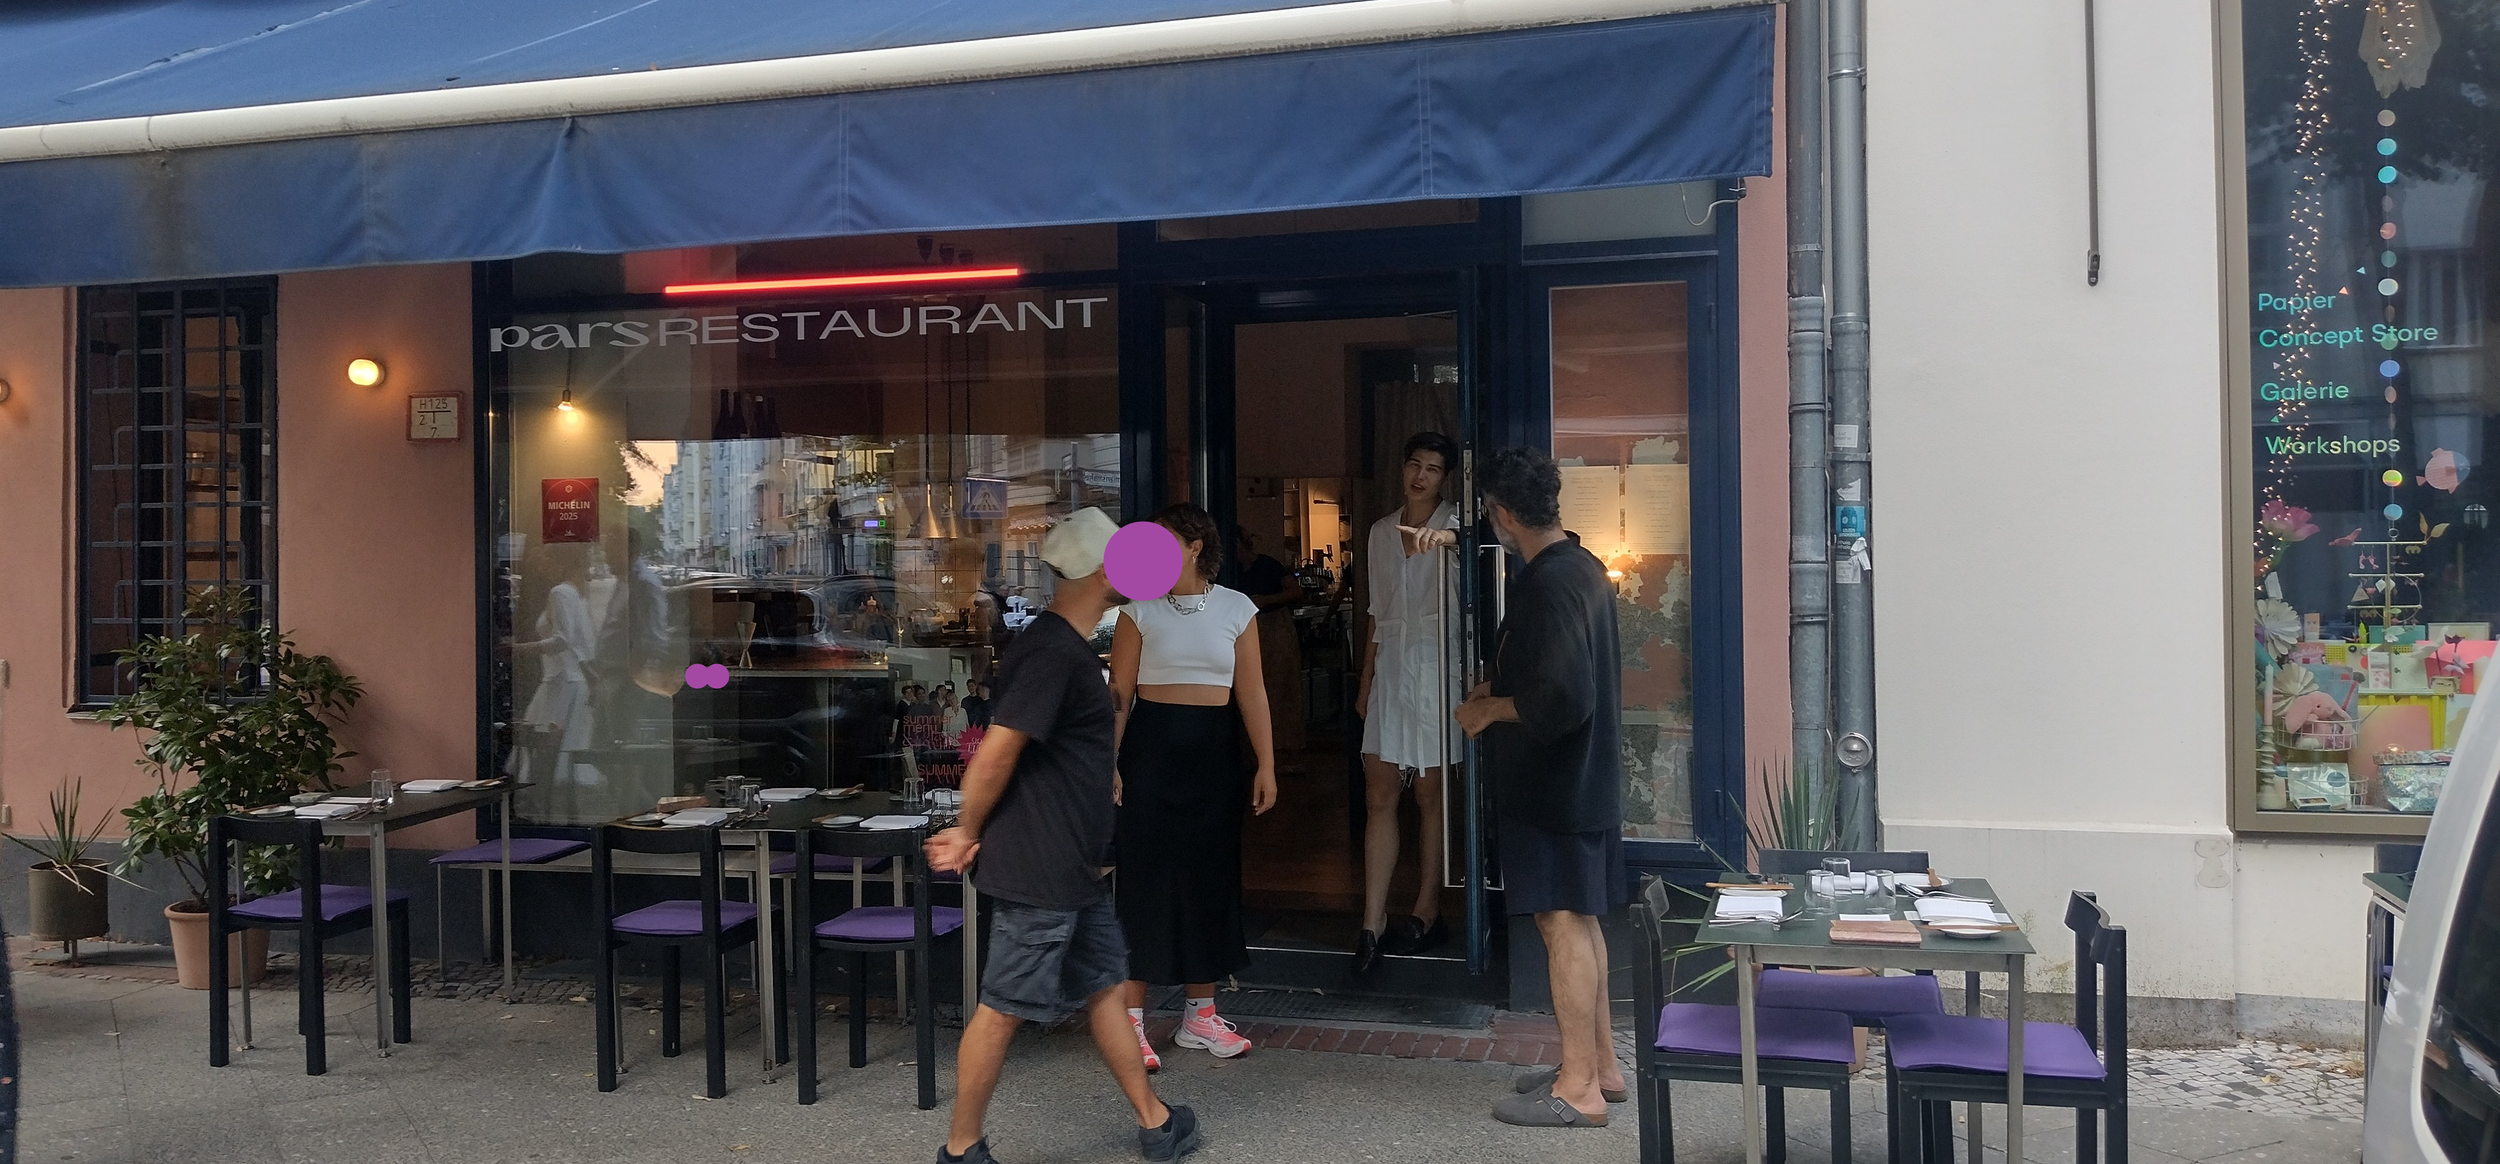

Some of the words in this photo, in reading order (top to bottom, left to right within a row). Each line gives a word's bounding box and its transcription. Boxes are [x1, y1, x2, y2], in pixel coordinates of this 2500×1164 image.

[2258, 293, 2336, 315] Papier
[490, 321, 650, 352] pars
[659, 297, 1108, 347] RESTAURANT
[2259, 326, 2364, 349] Concept
[2371, 323, 2439, 343] Store
[2260, 381, 2350, 402] Galerie
[419, 398, 448, 410] H125
[2265, 435, 2401, 458] Workshops
[548, 501, 590, 510] MICHELIN
[559, 512, 579, 521] 2025
[903, 715, 953, 725] summer
[903, 724, 938, 733] menu
[917, 764, 967, 779] SUMME
